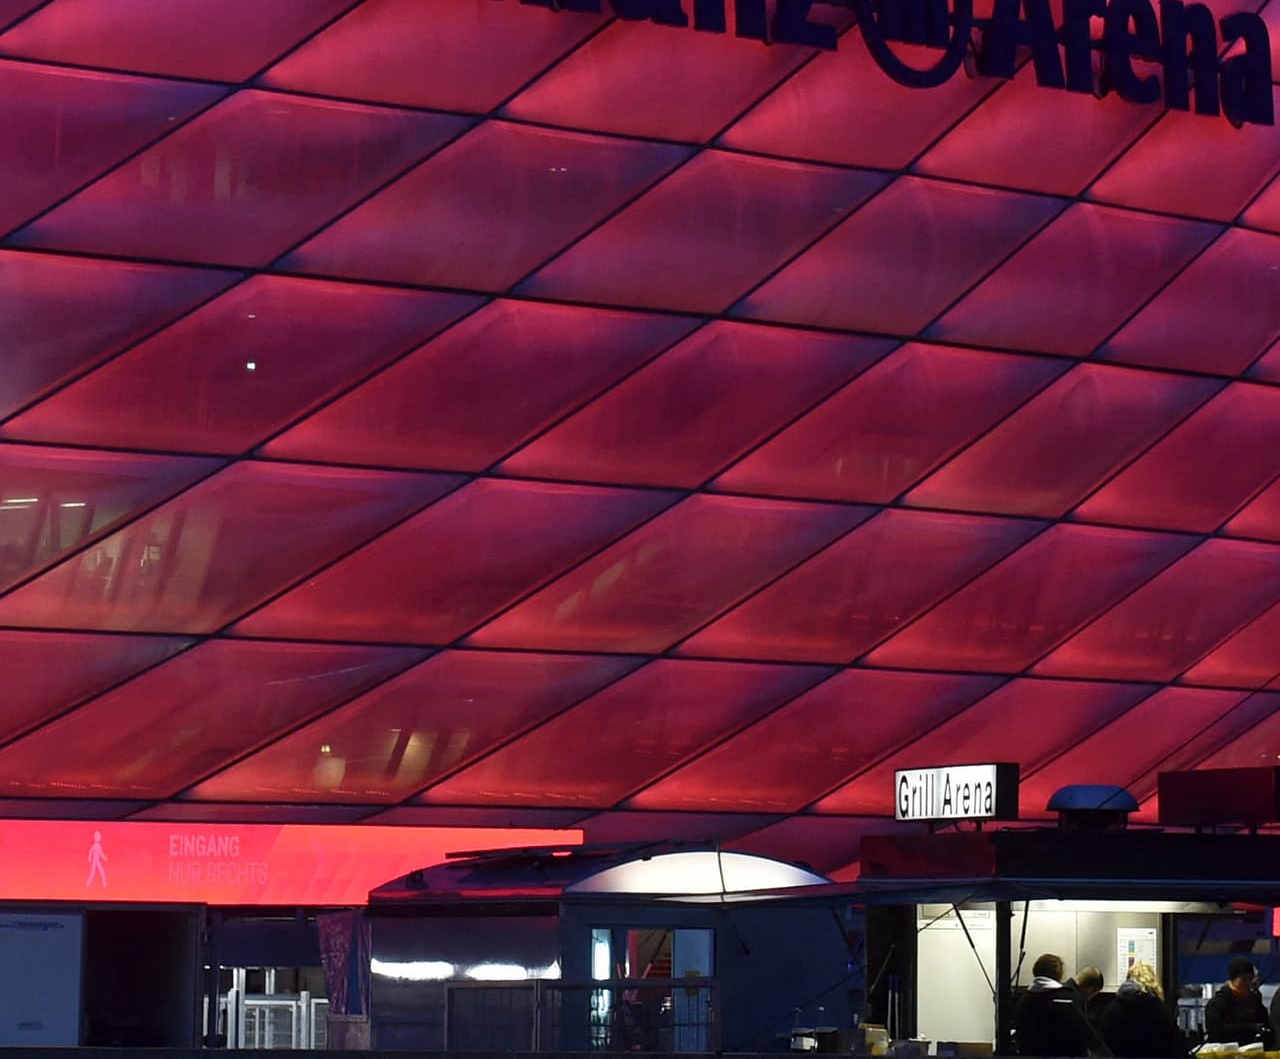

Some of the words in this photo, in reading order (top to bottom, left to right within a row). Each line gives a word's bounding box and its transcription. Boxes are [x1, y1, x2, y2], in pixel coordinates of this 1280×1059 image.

[899, 774, 934, 818] Grill
[942, 773, 993, 816] Arena
[169, 835, 241, 857] EINGANG
[169, 862, 202, 883] NUR
